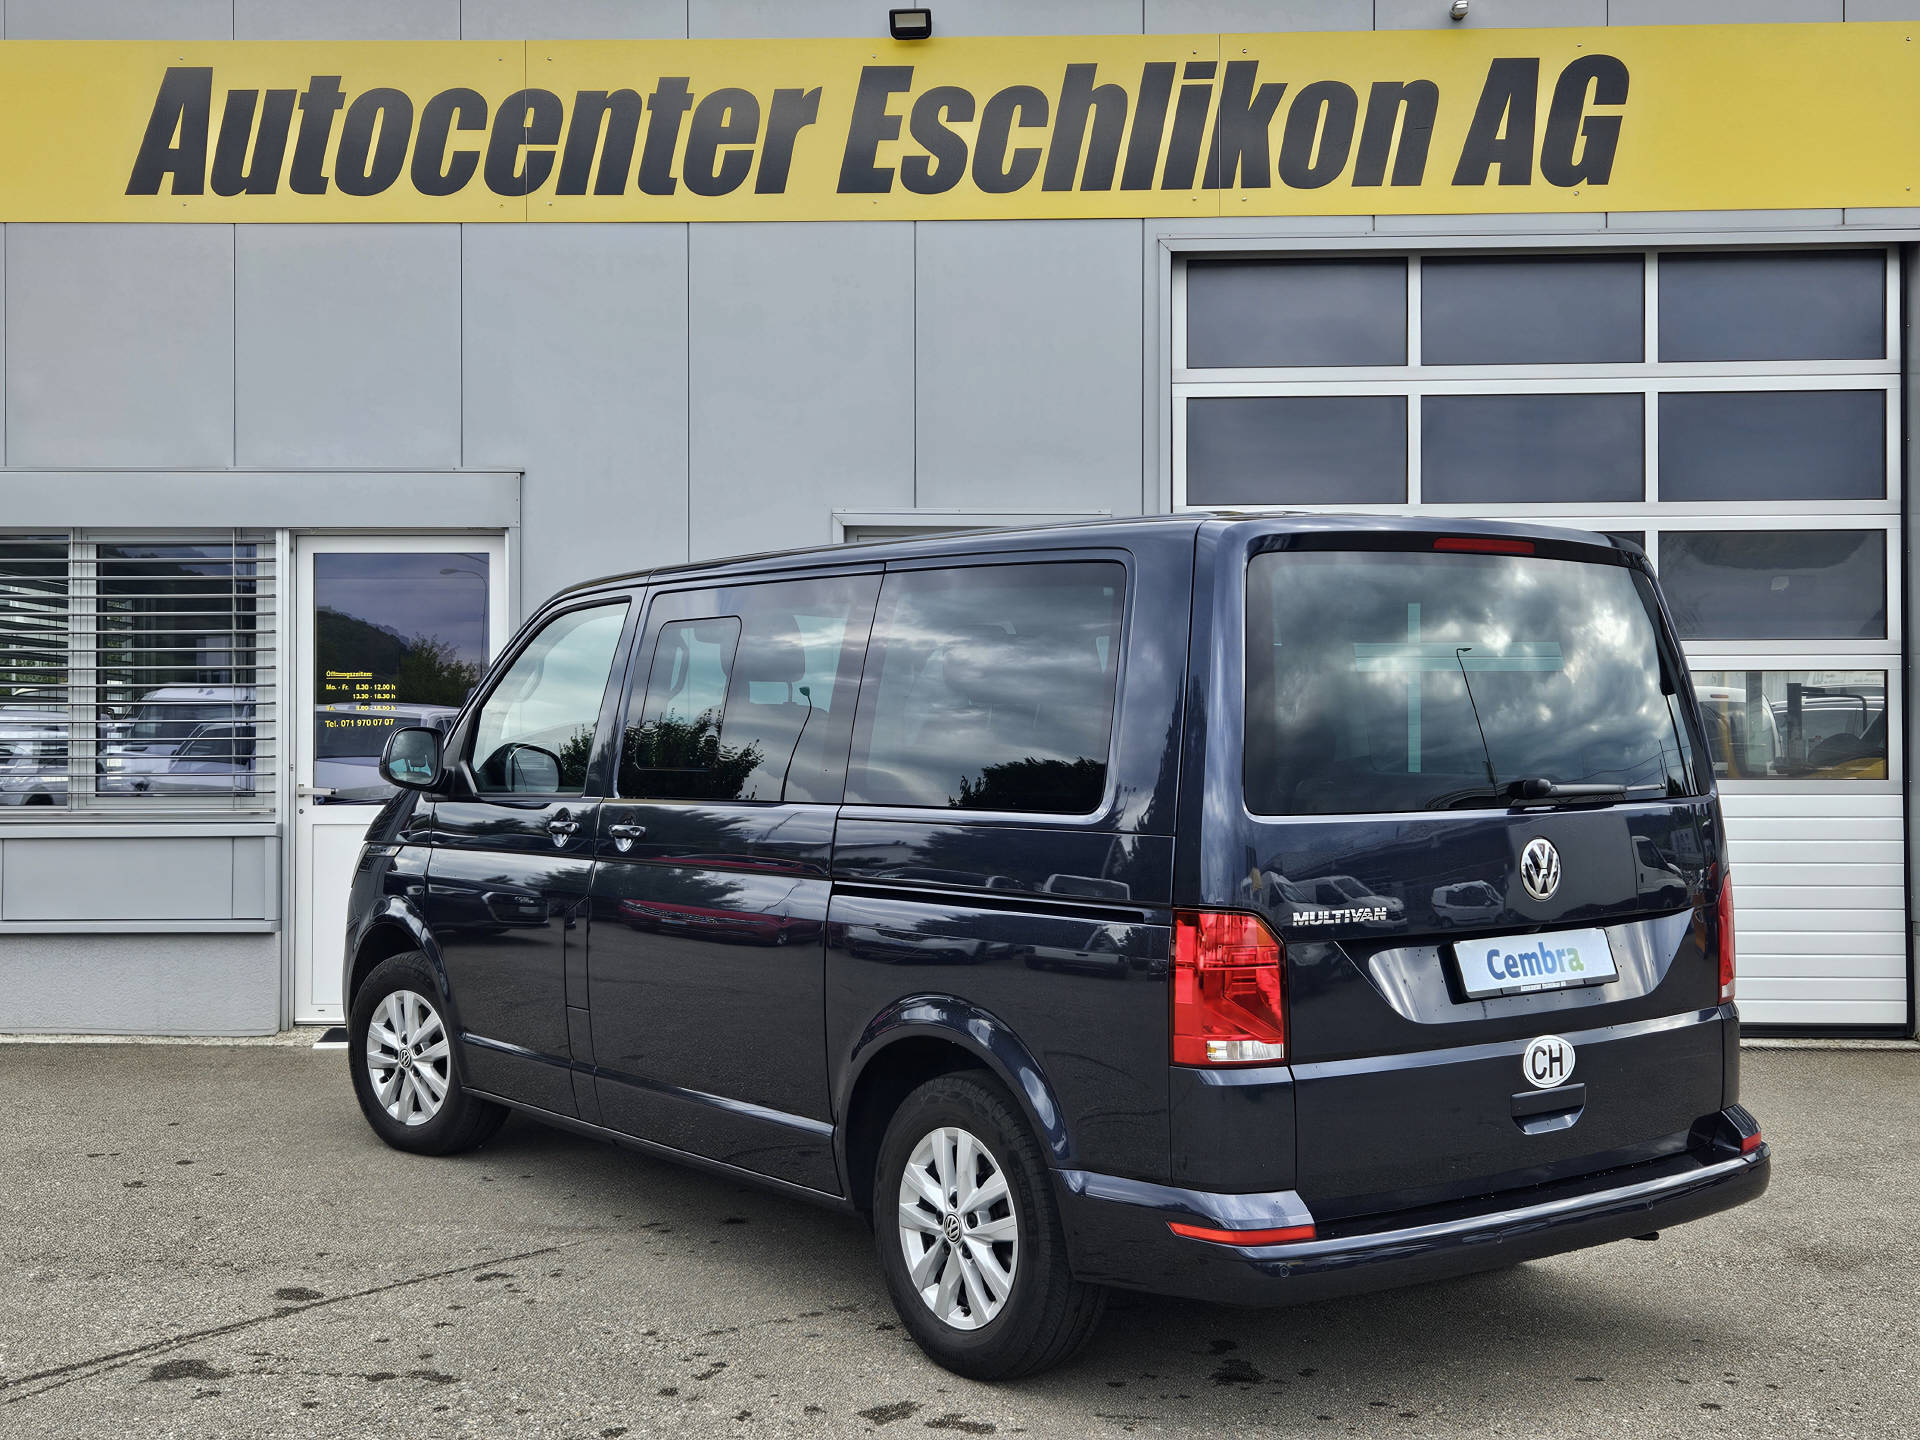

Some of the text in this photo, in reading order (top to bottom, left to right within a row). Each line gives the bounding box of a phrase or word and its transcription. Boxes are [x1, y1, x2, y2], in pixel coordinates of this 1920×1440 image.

[125, 54, 1629, 197] Autocenter Eschlikon AG
[325, 718, 395, 728] Tel. 071 970 07 07
[1292, 907, 1387, 926] MULTIVAN
[1486, 941, 1585, 981] Cembra
[1532, 1043, 1563, 1080] CH
